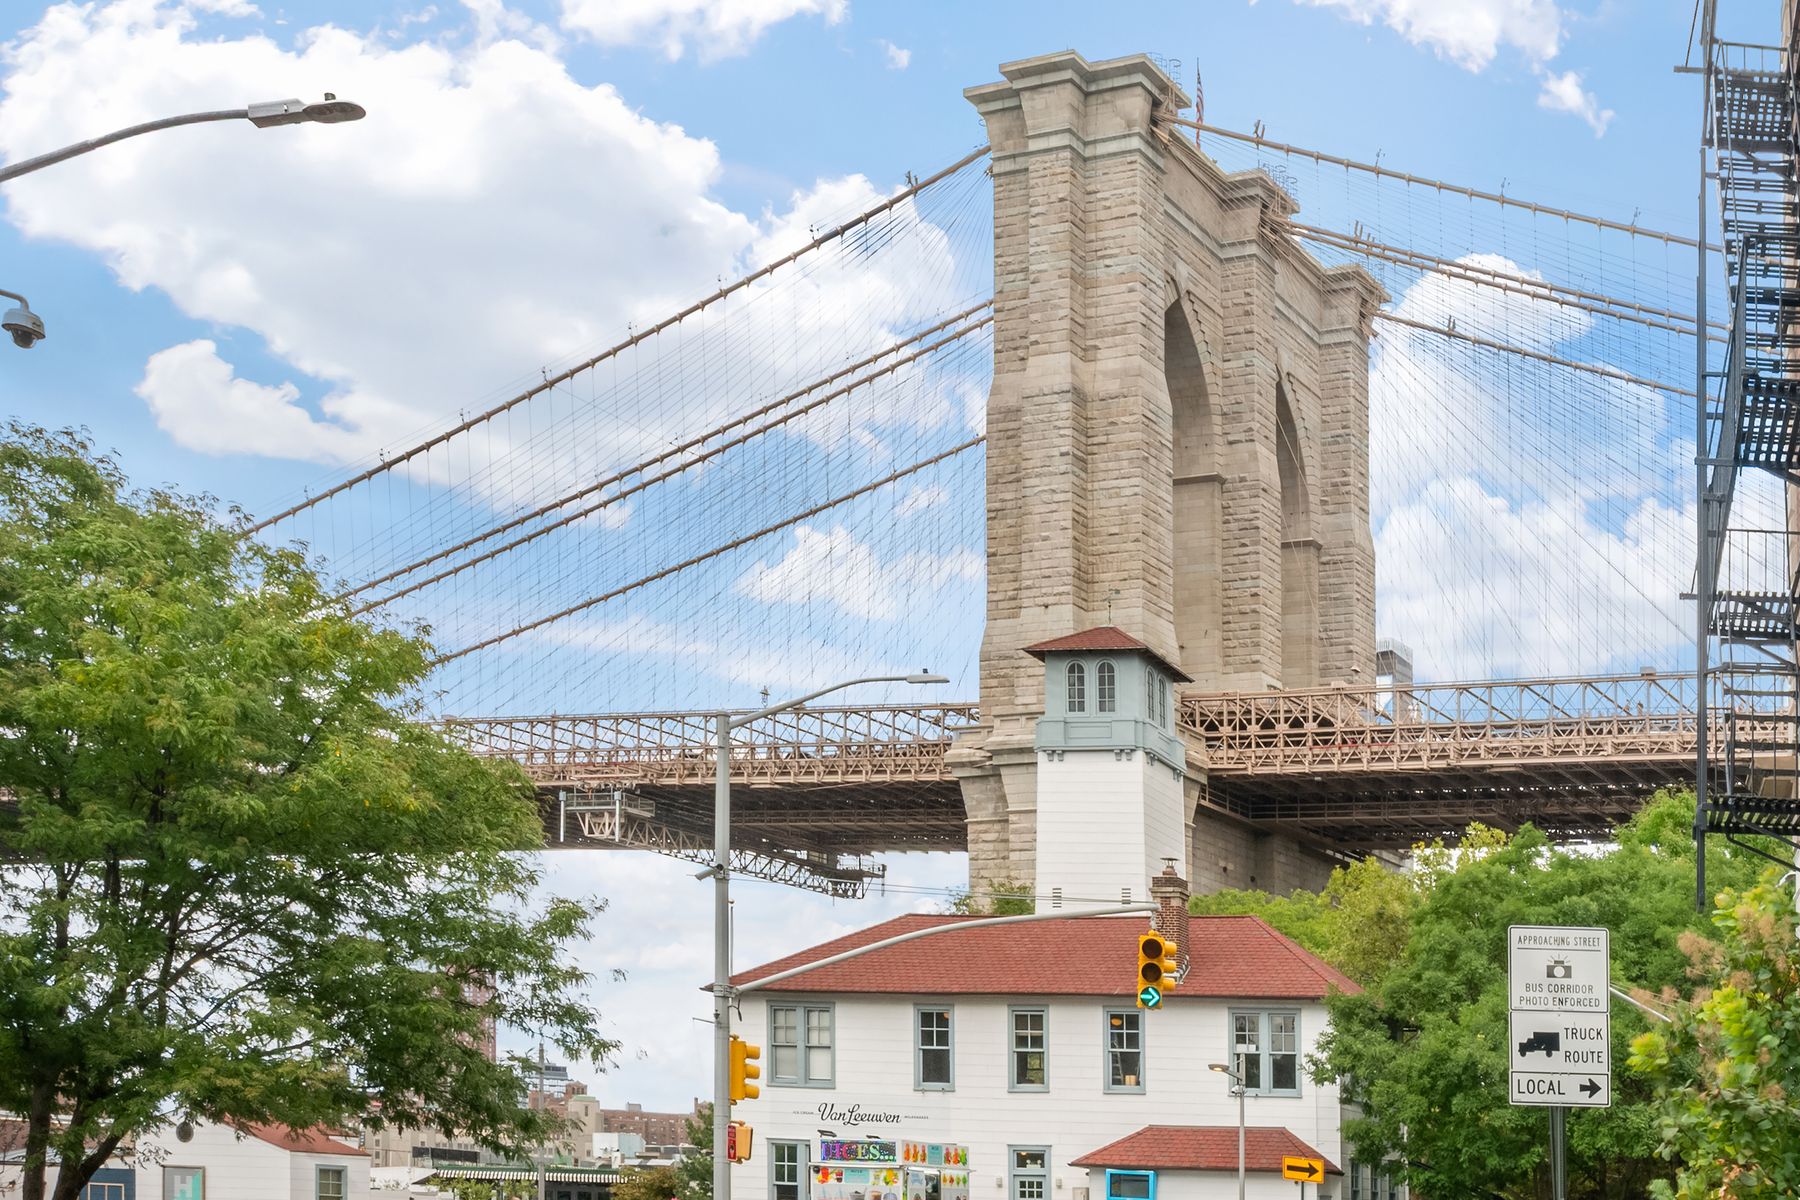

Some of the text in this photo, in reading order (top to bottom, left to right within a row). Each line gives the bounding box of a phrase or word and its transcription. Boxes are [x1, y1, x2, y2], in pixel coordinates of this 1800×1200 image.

[1518, 935, 1600, 947] APPROACHING STREET
[1525, 982, 1593, 994] BUS CORRIDOR
[1519, 996, 1600, 1008] PHOTO ENFORCED
[1563, 1027, 1603, 1040] TRUCK
[1564, 1050, 1603, 1064] ROUTE
[1517, 1078, 1565, 1095] LOCAL
